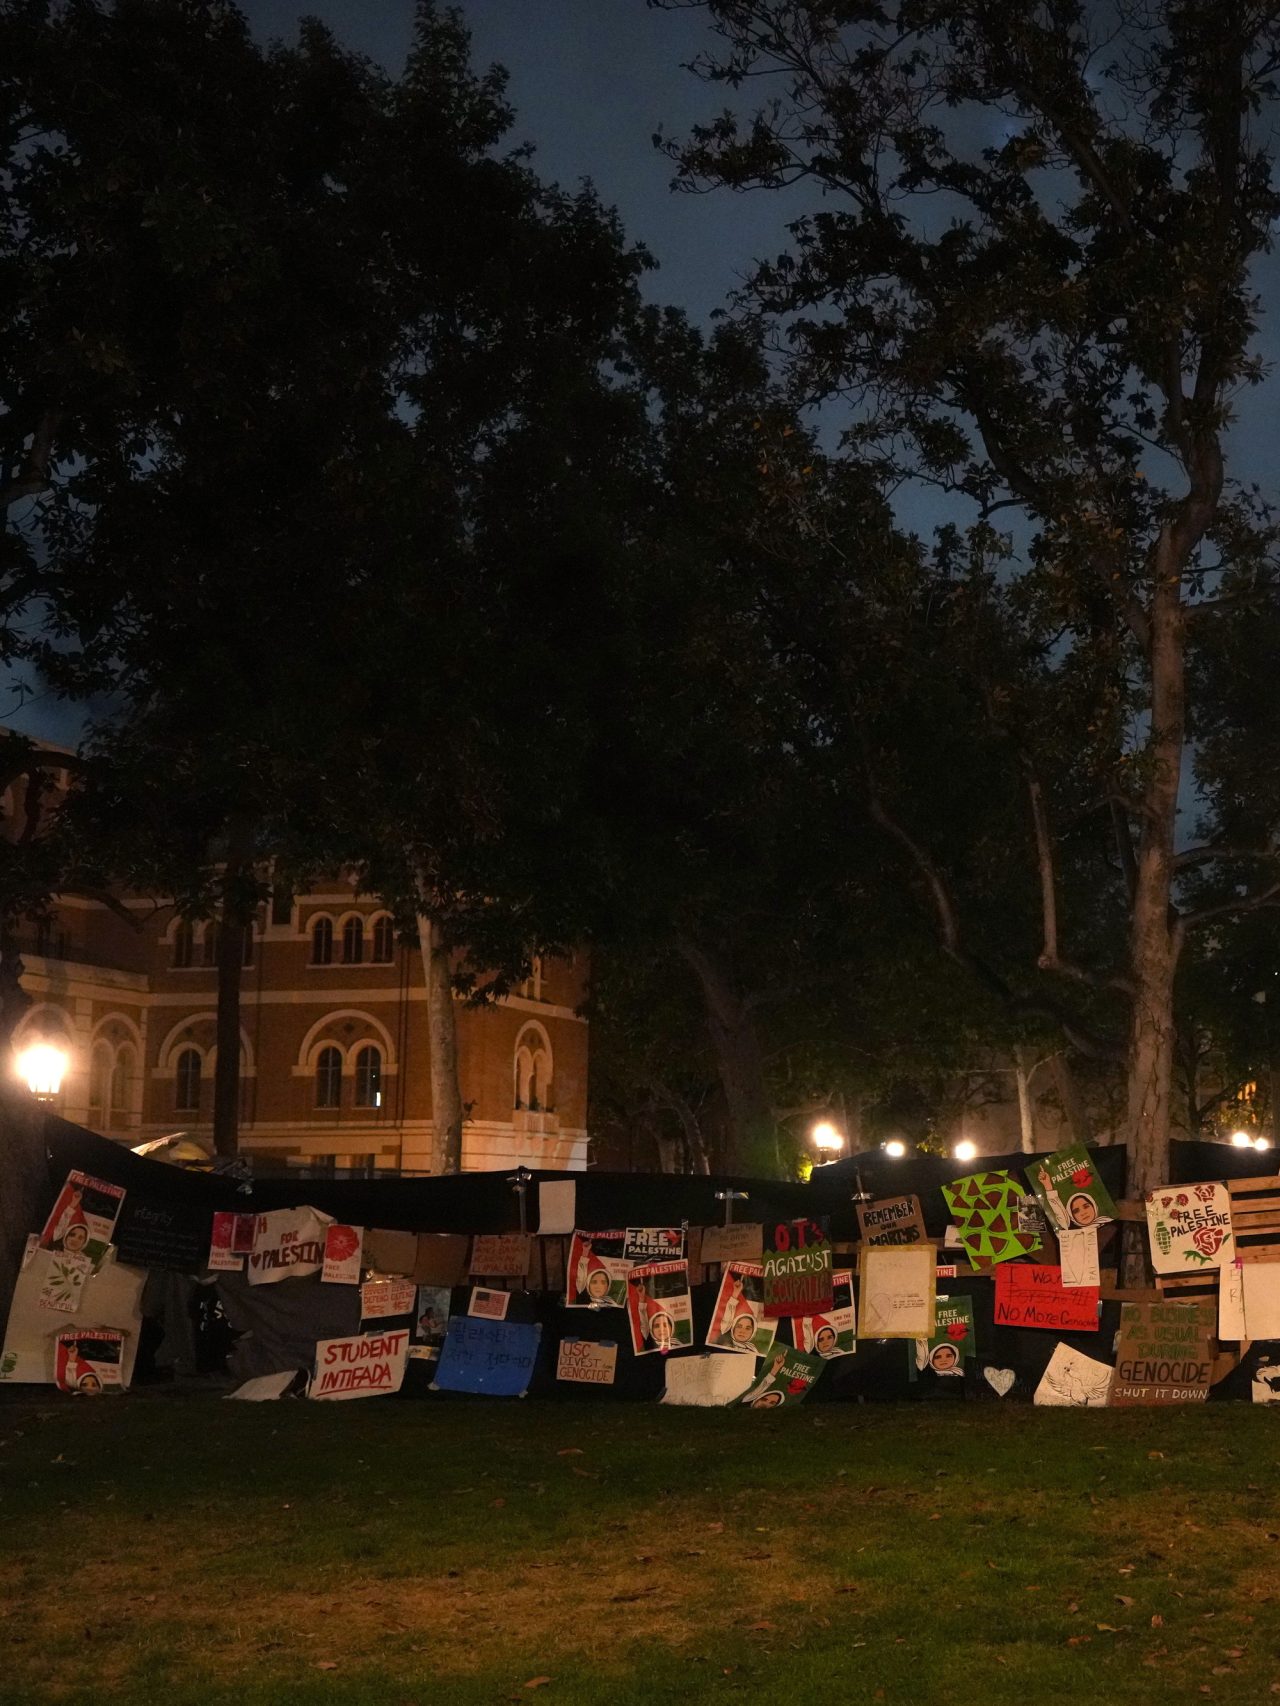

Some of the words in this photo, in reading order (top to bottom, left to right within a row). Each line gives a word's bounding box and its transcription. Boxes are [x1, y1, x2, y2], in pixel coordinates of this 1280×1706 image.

[1051, 1160, 1090, 1184] PALESTINE
[1057, 1158, 1077, 1172] FREE
[863, 1201, 914, 1227] REMEMBER
[1177, 1205, 1217, 1223] FREE
[1170, 1213, 1230, 1237] PALESTINE
[281, 1230, 299, 1245] FOR
[626, 1232, 668, 1246] FREE
[628, 1246, 681, 1255] PALESTINE
[629, 1269, 646, 1279] FREE
[646, 1262, 686, 1277] PALESTINE
[731, 1263, 747, 1274] FREE
[764, 1249, 831, 1278] AGAINST
[938, 1309, 958, 1318] FREE
[1123, 1309, 1140, 1321] NO
[1152, 1307, 1215, 1326] BUSINESS
[80, 1331, 121, 1340] PALESTINE
[1127, 1327, 1146, 1340] AS
[1154, 1326, 1201, 1341] USUAL
[324, 1334, 408, 1365] STUDENT
[563, 1344, 590, 1357] USC
[1137, 1343, 1198, 1359] DURING
[560, 1357, 601, 1368] DIVEST
[793, 1363, 810, 1374] FREE
[321, 1362, 391, 1389] INTIFADA
[560, 1368, 609, 1381] GENOCIDE
[780, 1366, 815, 1384] PALESTINE
[1119, 1360, 1211, 1383] GENOCIDE
[1114, 1387, 1150, 1397] SHUT
[1155, 1389, 1169, 1398] IT
[1172, 1389, 1208, 1399] DOWN
